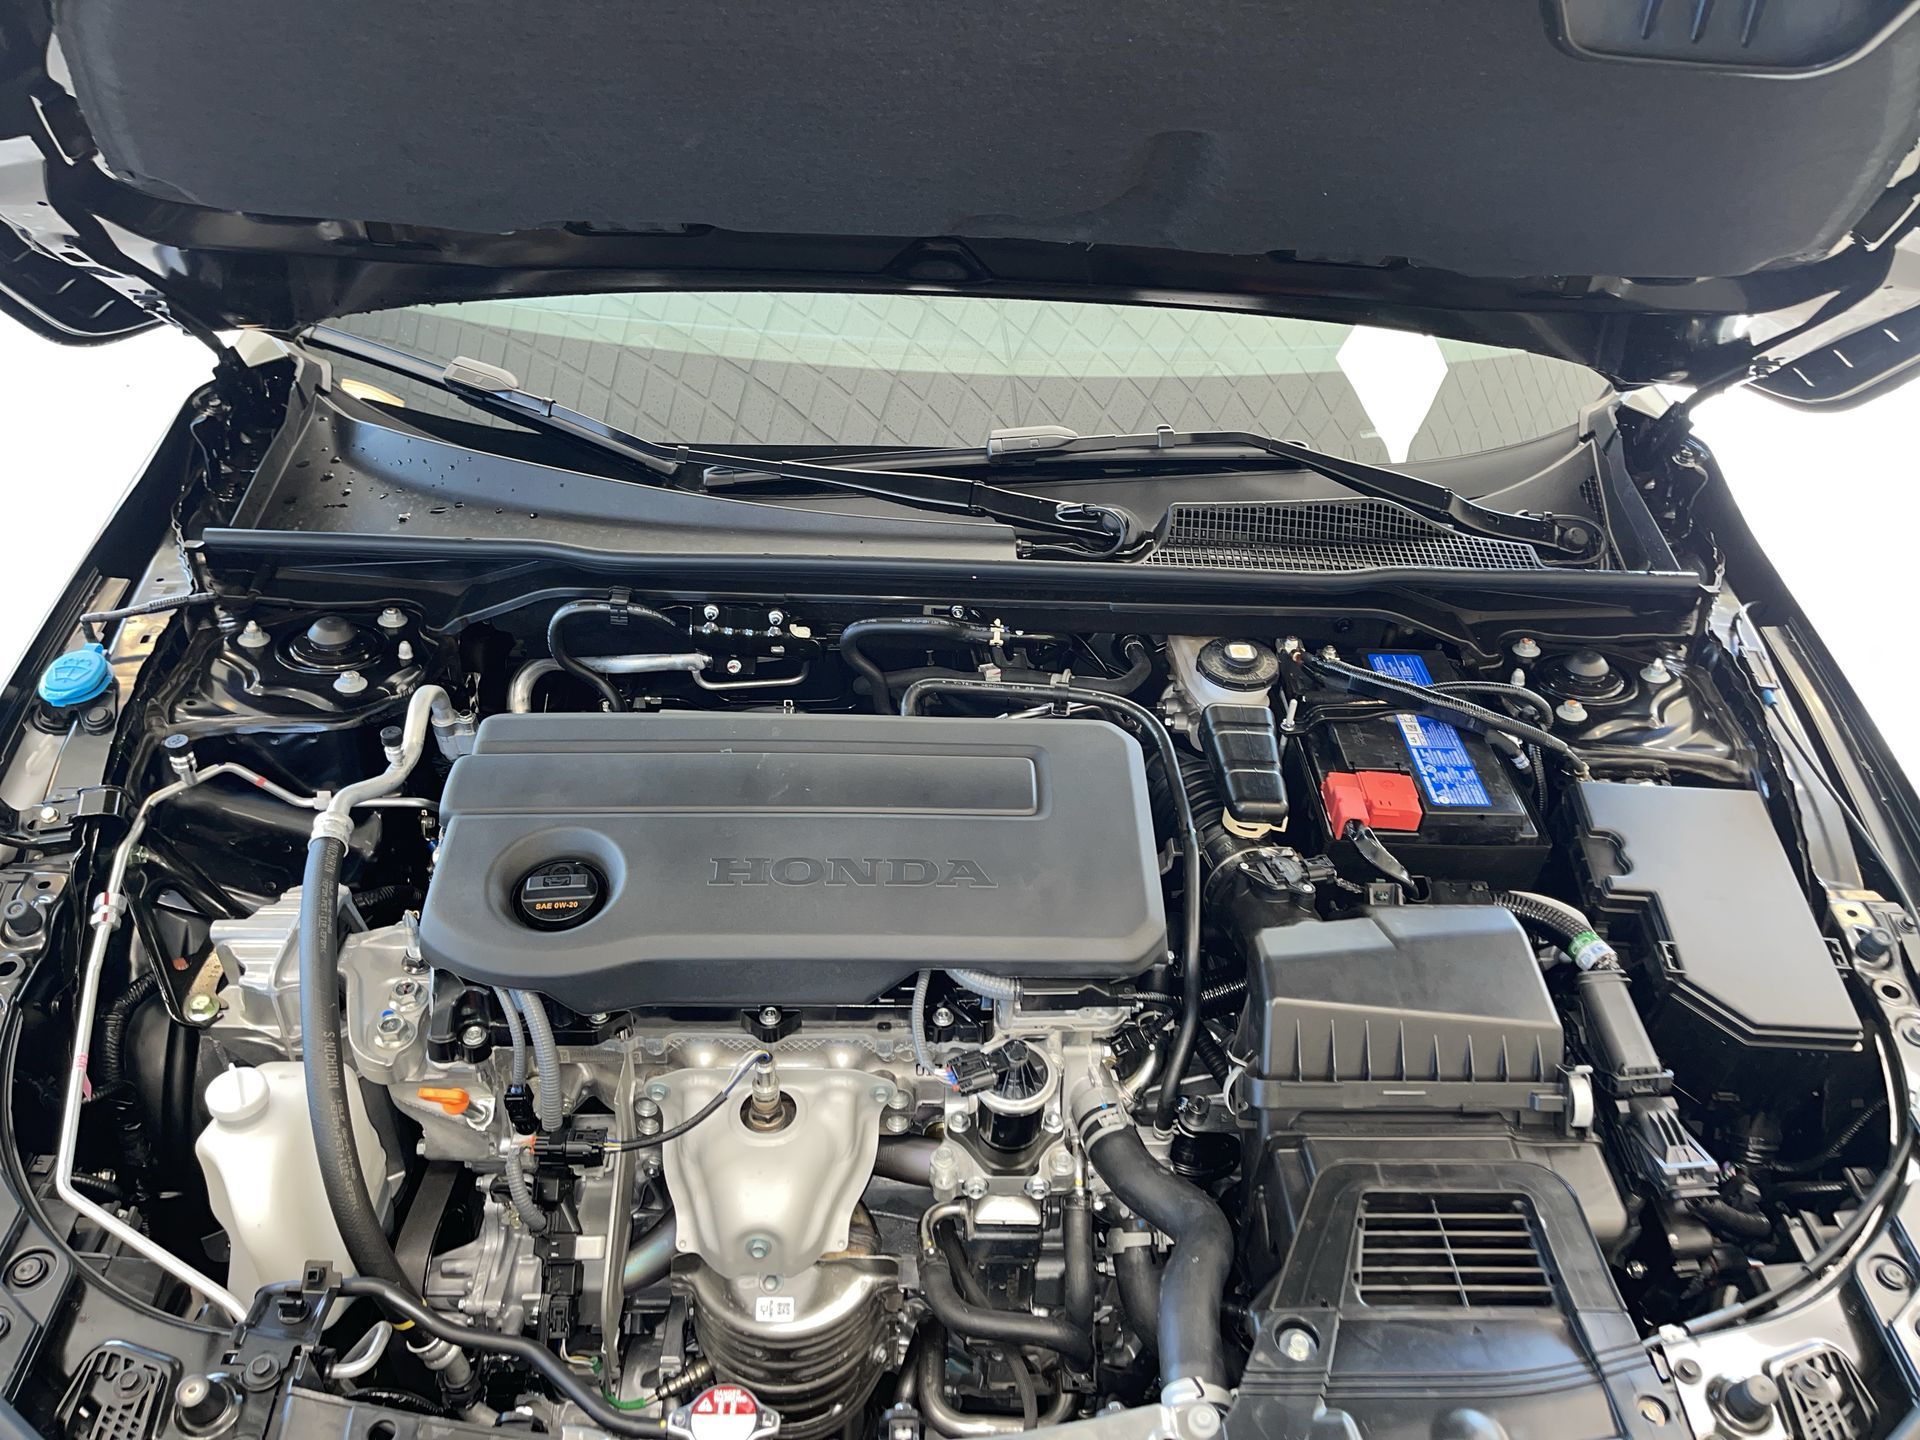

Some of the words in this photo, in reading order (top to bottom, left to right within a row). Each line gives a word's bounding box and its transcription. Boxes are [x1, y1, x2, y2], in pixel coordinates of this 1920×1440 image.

[707, 857, 999, 888] HONDA
[535, 902, 553, 910] SAE
[553, 901, 579, 909] 0W-20
